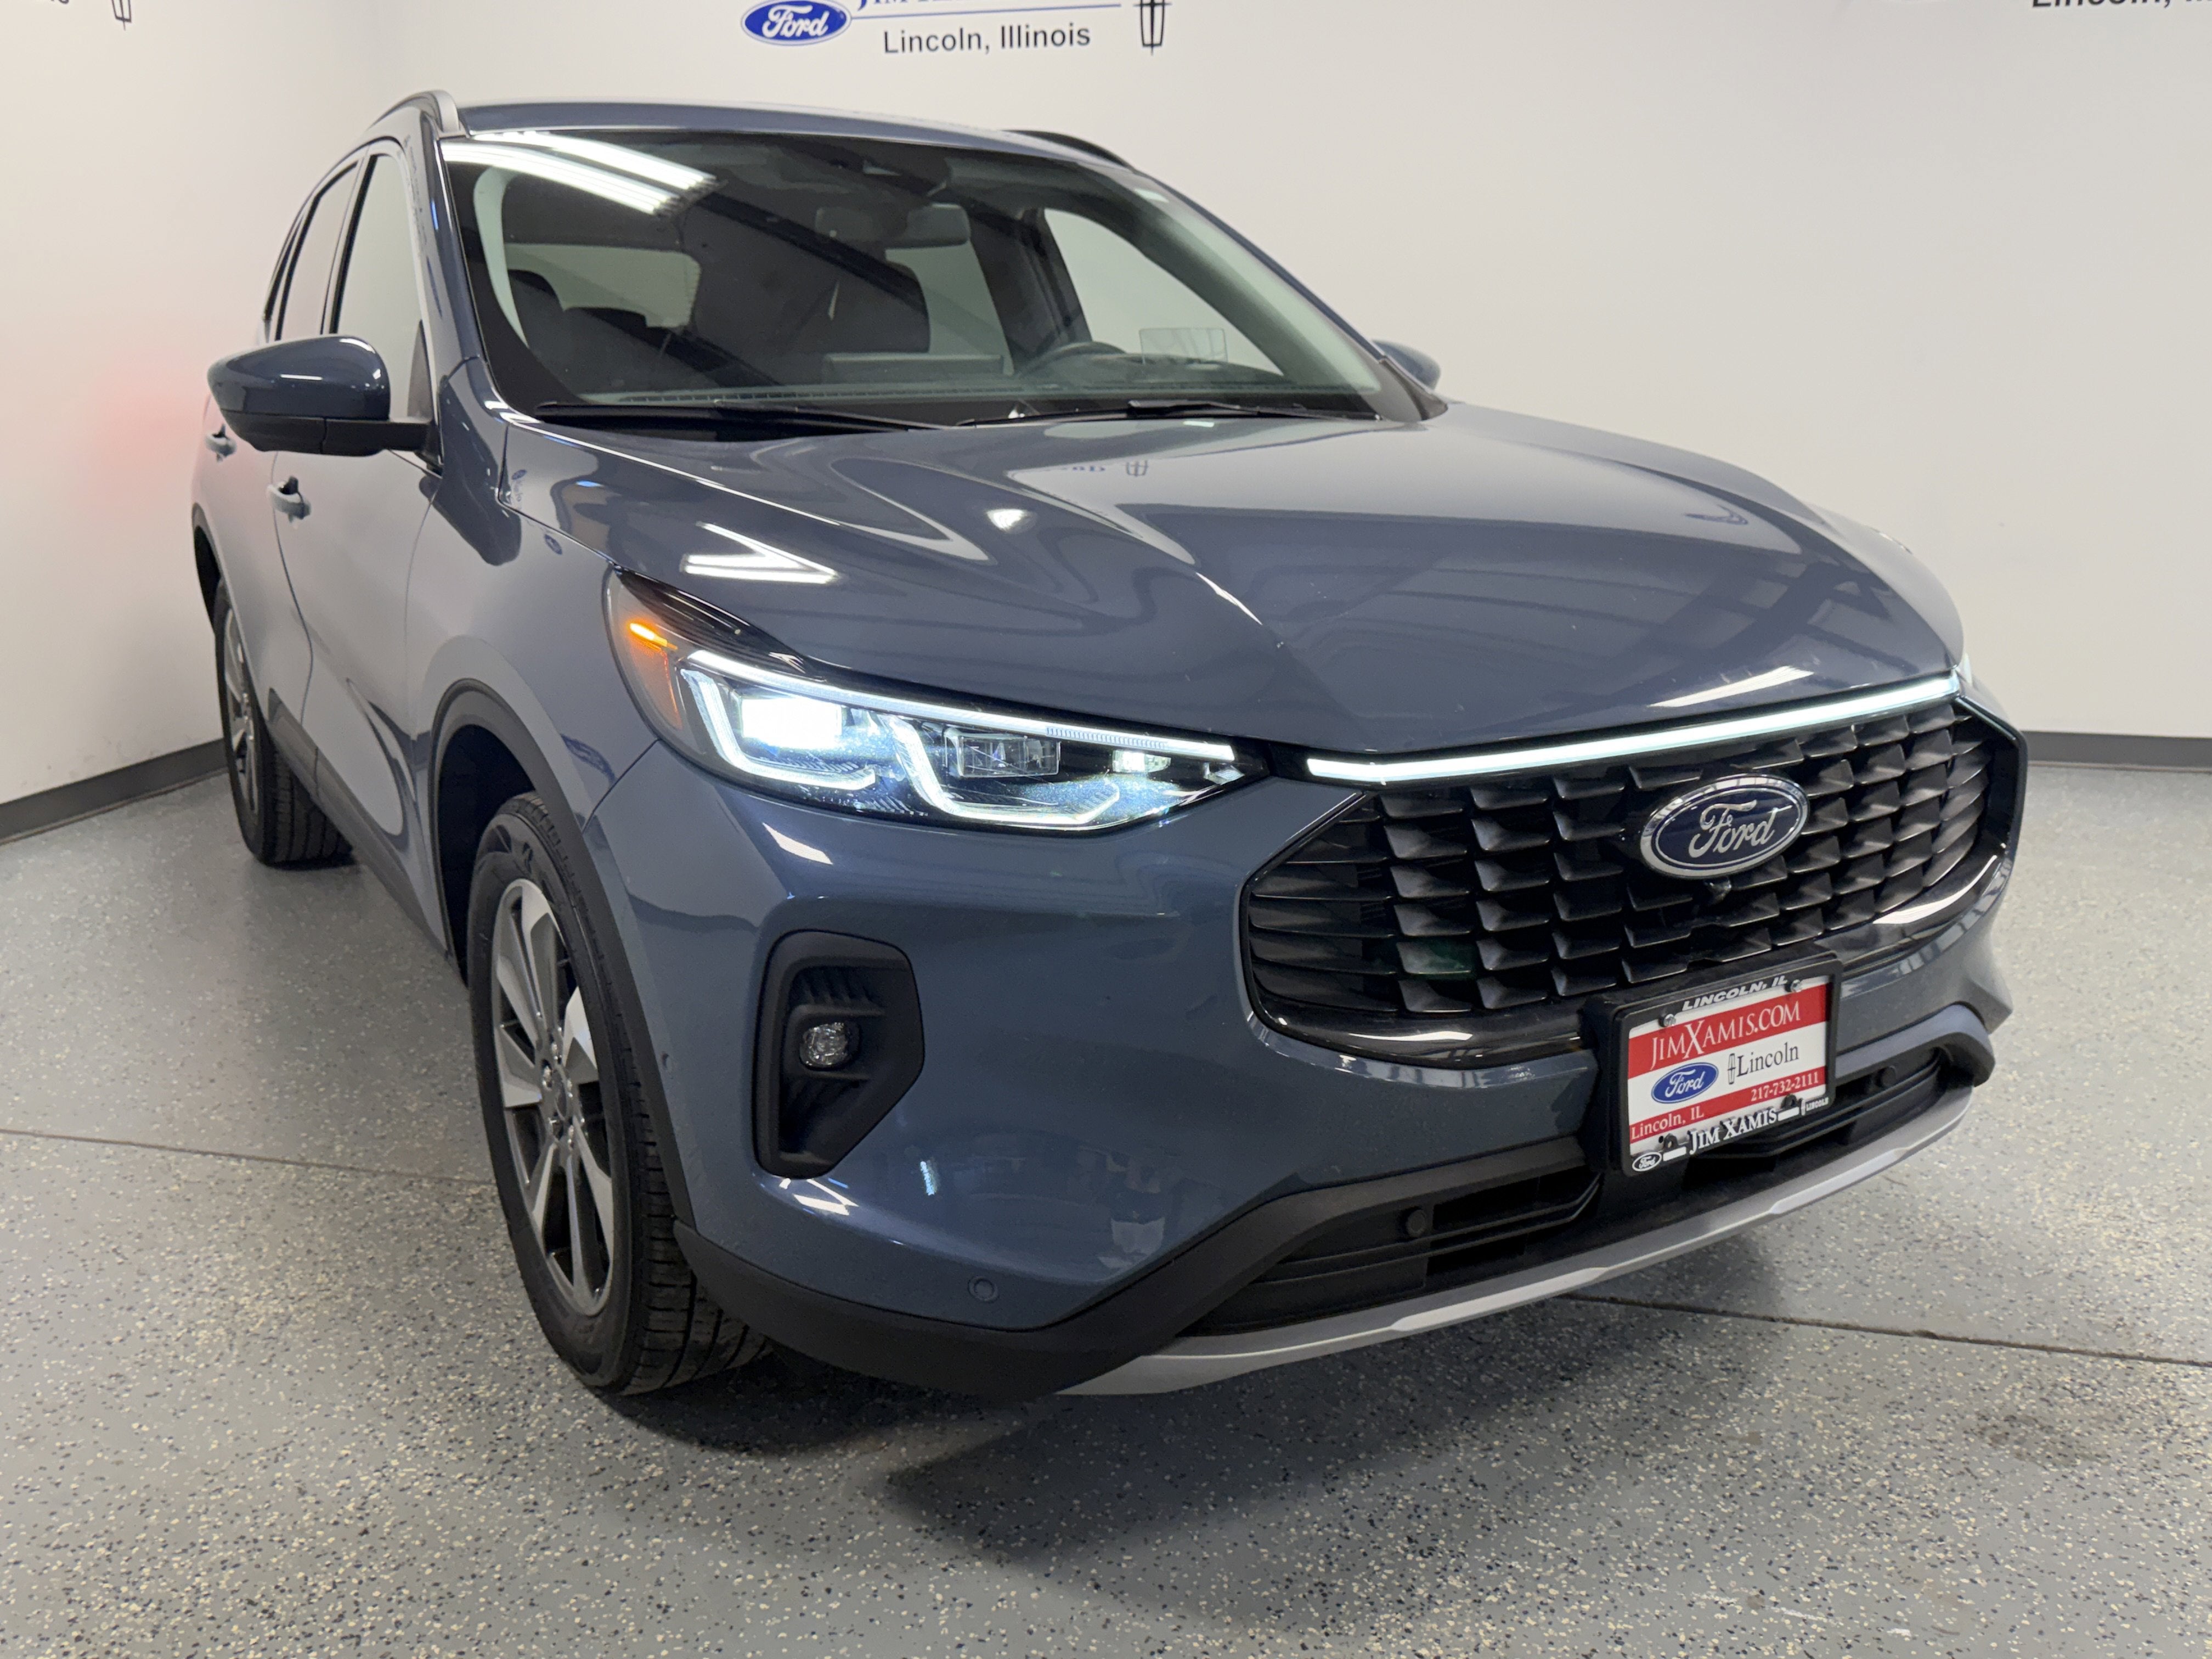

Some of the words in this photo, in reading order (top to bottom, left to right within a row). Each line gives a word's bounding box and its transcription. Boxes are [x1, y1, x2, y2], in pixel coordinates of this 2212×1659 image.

[762, 4, 830, 38] Ford
[883, 27, 990, 54] Lincoln,
[1001, 22, 1091, 49] Illinois
[1689, 799, 1776, 858] Ford
[1682, 981, 1767, 1011] LINCOLN,
[1771, 975, 1788, 987] IL
[1650, 1001, 1801, 1070] JIMXAMIS.COM
[1737, 1042, 1799, 1077] Lincoln
[1664, 1069, 1705, 1098] Ford
[1751, 1071, 1819, 1102] 217-732-2111
[1631, 1113, 1686, 1139] Lincoln,
[1690, 1106, 1705, 1120] IL
[1689, 1127, 1720, 1155] JIM
[1723, 1108, 1777, 1140] XAMIS
[1638, 1155, 1656, 1169] Ford
